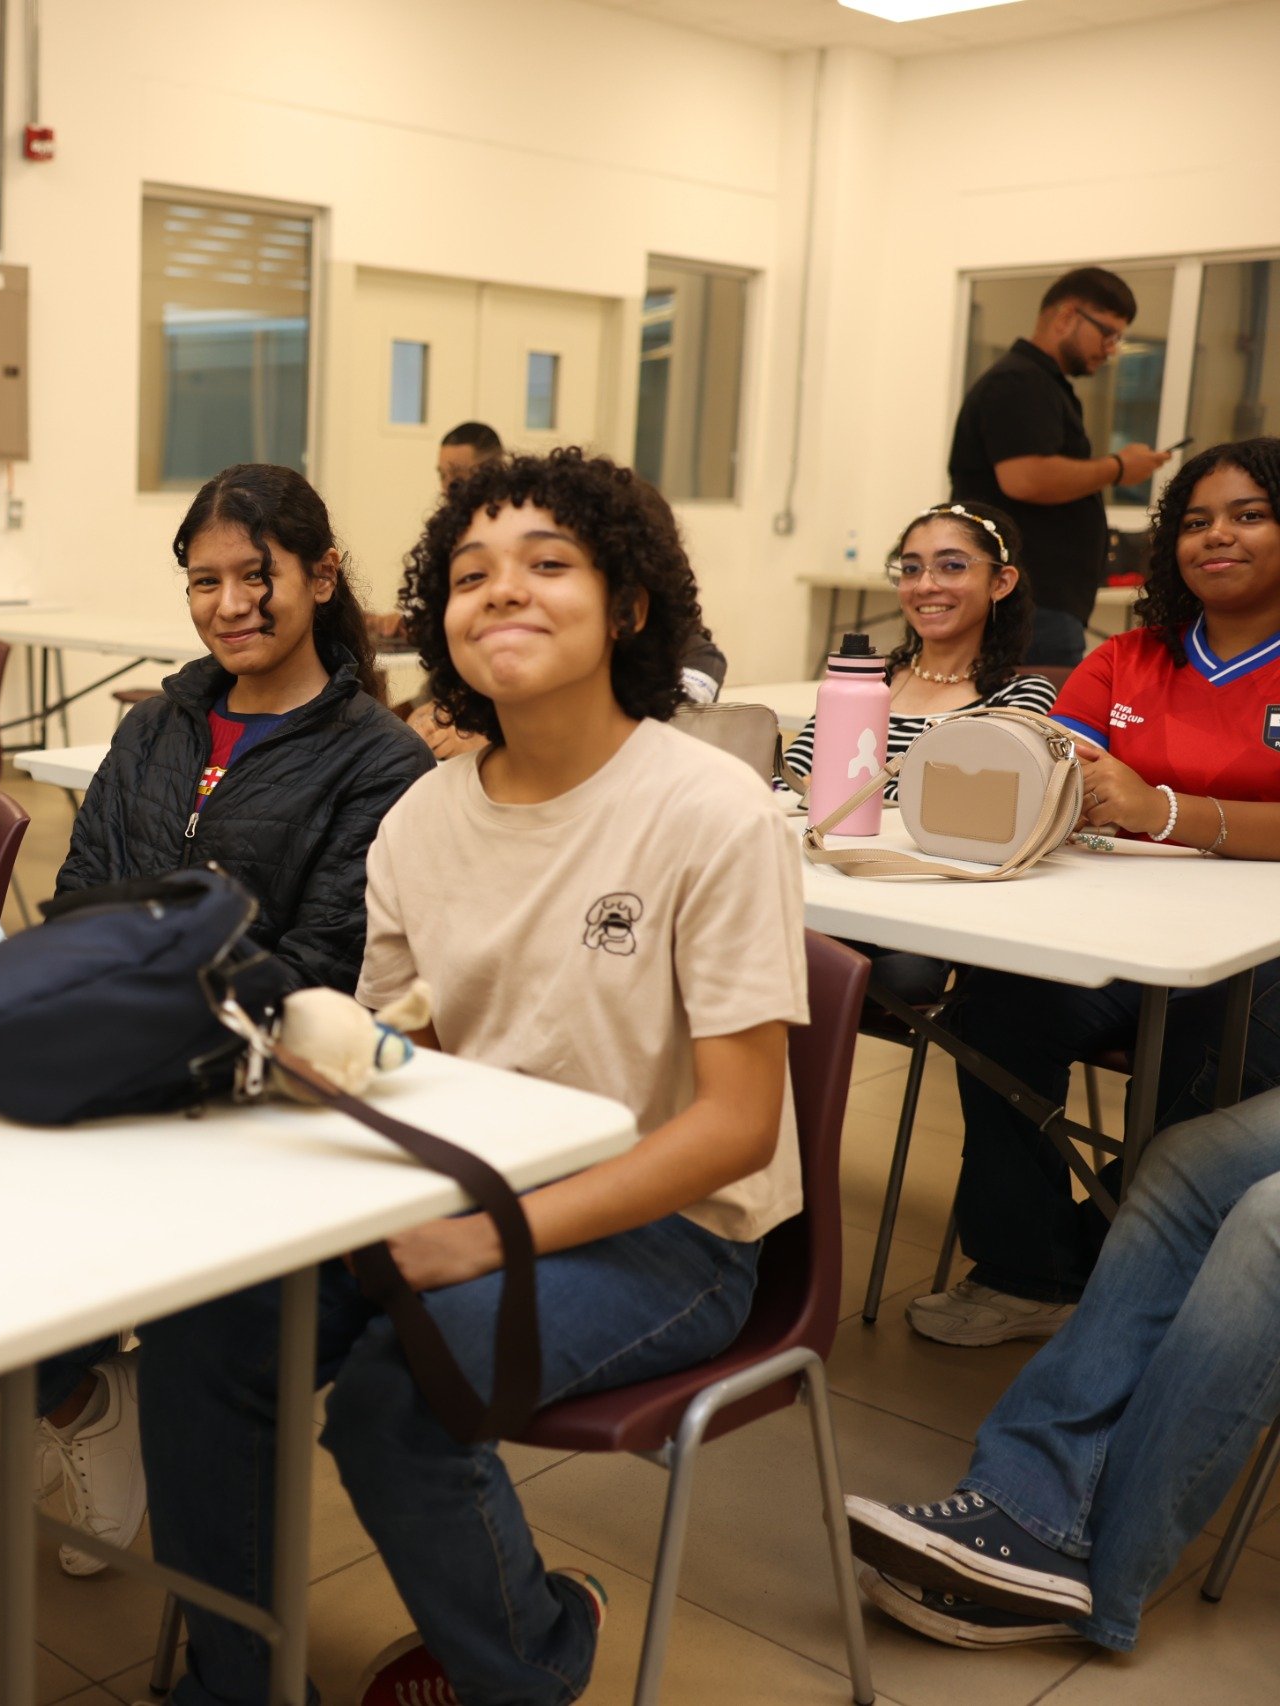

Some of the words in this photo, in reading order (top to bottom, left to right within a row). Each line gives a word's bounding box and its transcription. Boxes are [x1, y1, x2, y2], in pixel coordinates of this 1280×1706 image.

[1113, 702, 1133, 714] FIFA
[1110, 709, 1128, 721] RLD
[1127, 714, 1145, 724] CUP
